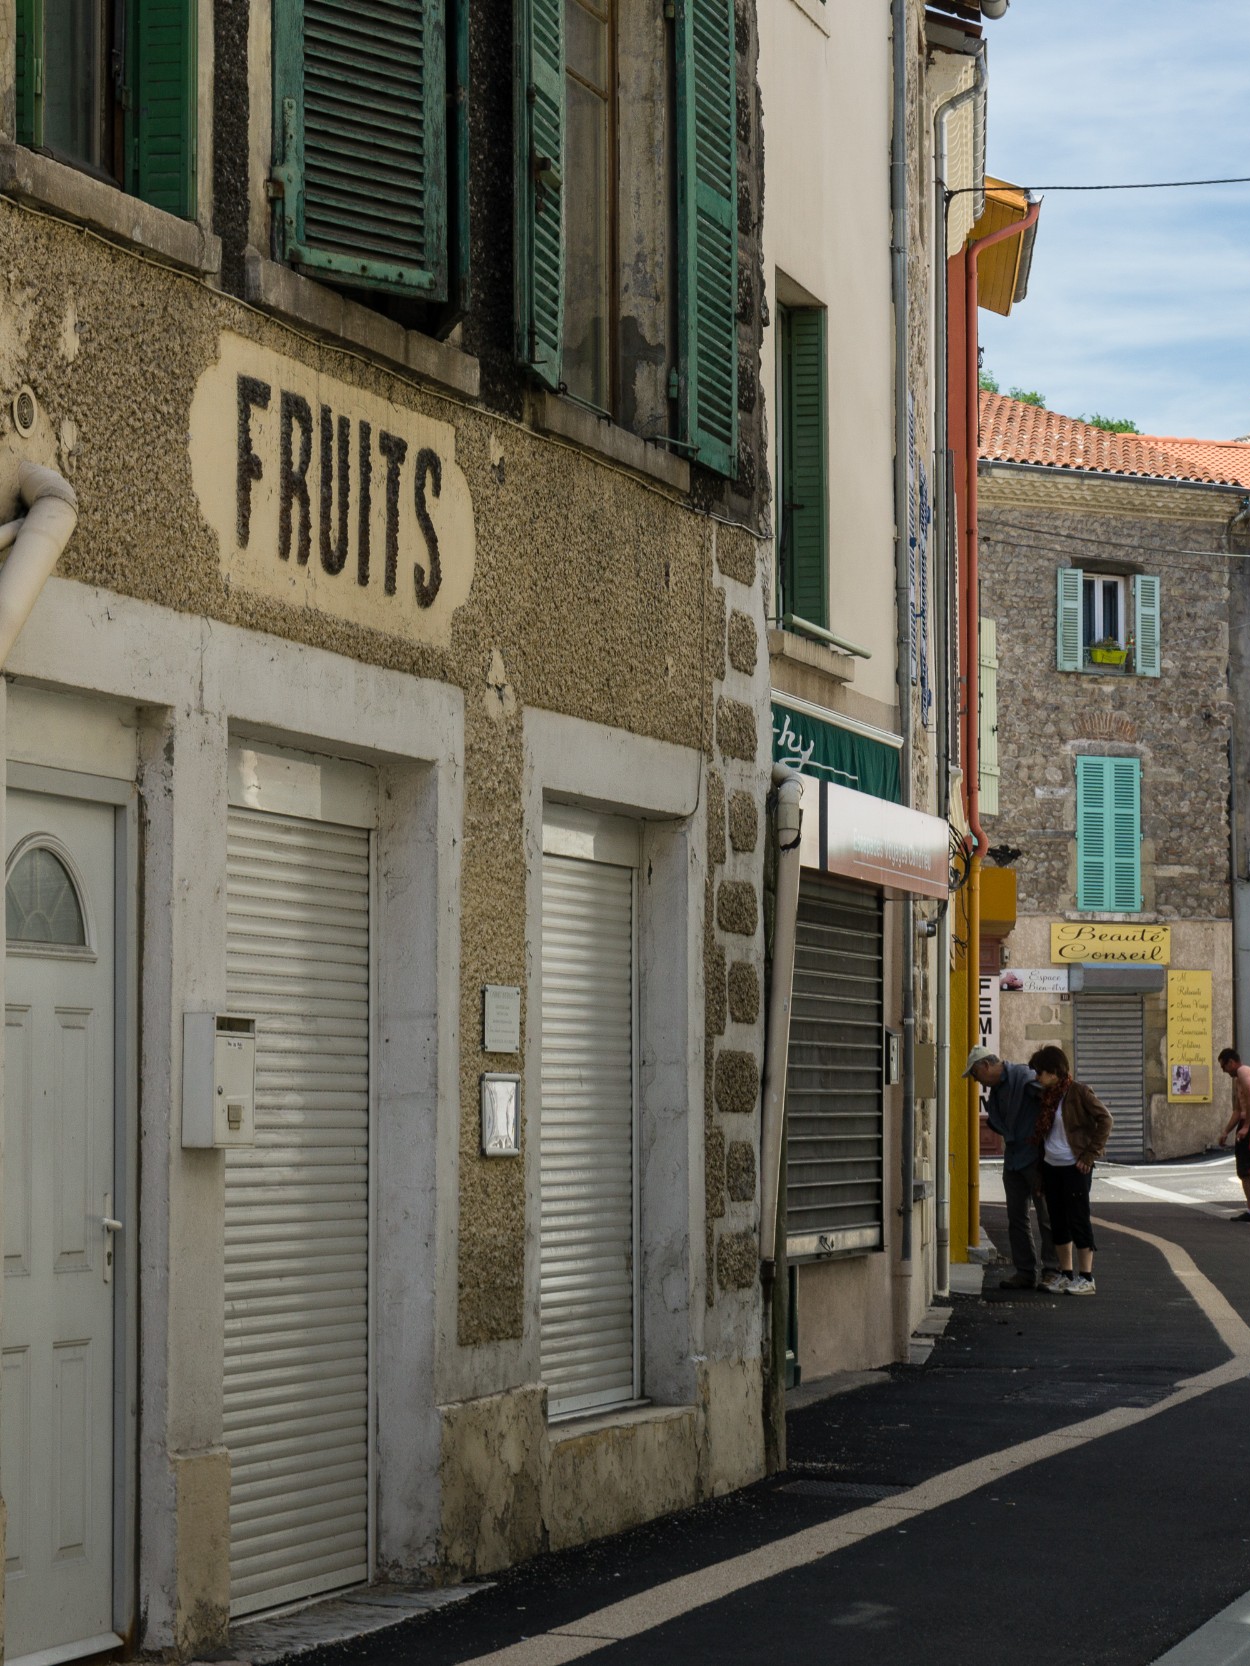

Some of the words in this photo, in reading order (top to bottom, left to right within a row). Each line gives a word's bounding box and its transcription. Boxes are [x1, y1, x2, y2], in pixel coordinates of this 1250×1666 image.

[236, 371, 443, 609] FRUITS
[1057, 925, 1165, 943] Beauté
[1058, 943, 1163, 960] Conseil
[1029, 969, 1062, 984] Espace
